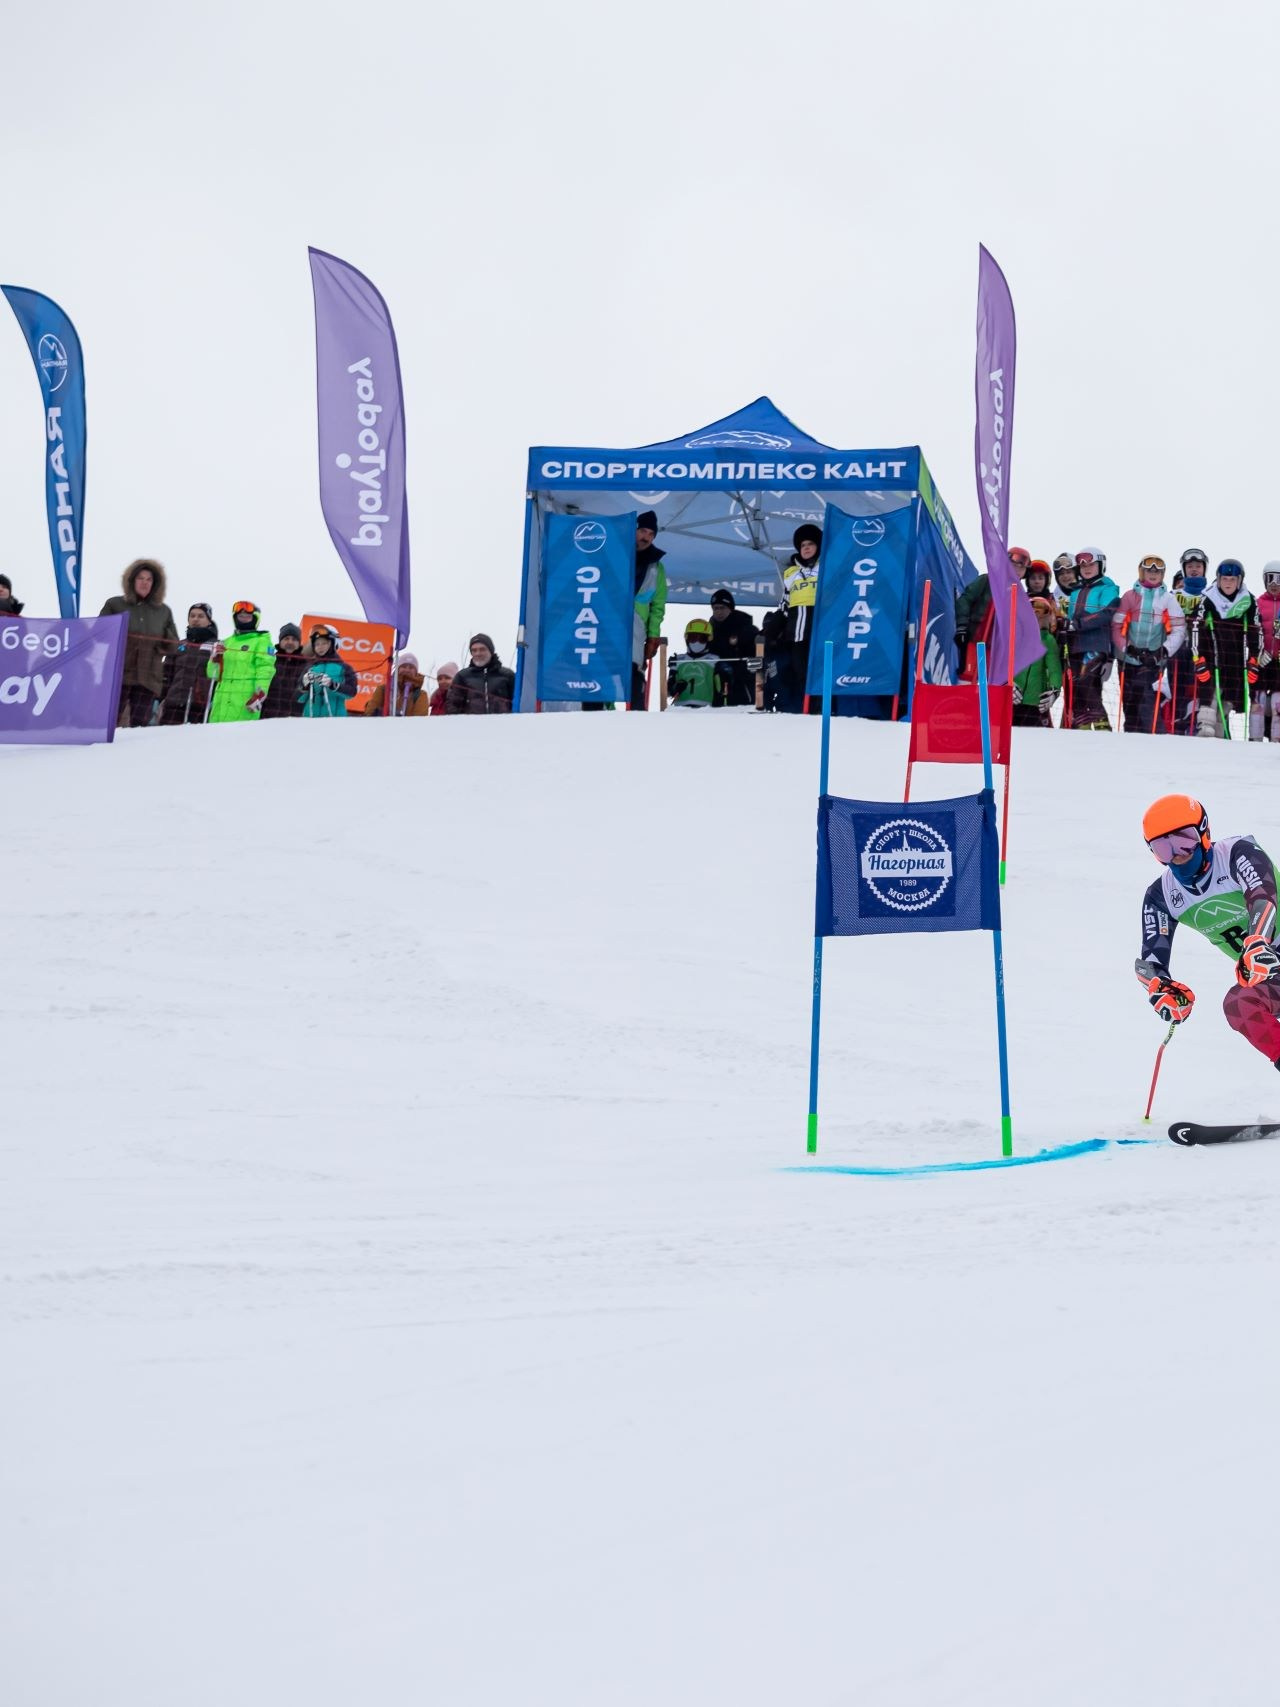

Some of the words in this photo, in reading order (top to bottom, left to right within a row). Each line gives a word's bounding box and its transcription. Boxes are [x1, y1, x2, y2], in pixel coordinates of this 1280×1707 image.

[541, 461, 817, 480] СПОРТКОМПЛЕКС
[823, 461, 907, 480] КАНТ
[847, 558, 878, 660] СТАРТ
[842, 675, 871, 684] КАНТ
[875, 829, 900, 851] СПОРТ
[908, 829, 937, 851] ШКОЛА
[868, 855, 945, 874] Нагорная
[1235, 854, 1263, 891] RUSSIA
[899, 879, 917, 887] 1989
[887, 887, 931, 902] МОСКВА
[1143, 904, 1157, 940] VIST
